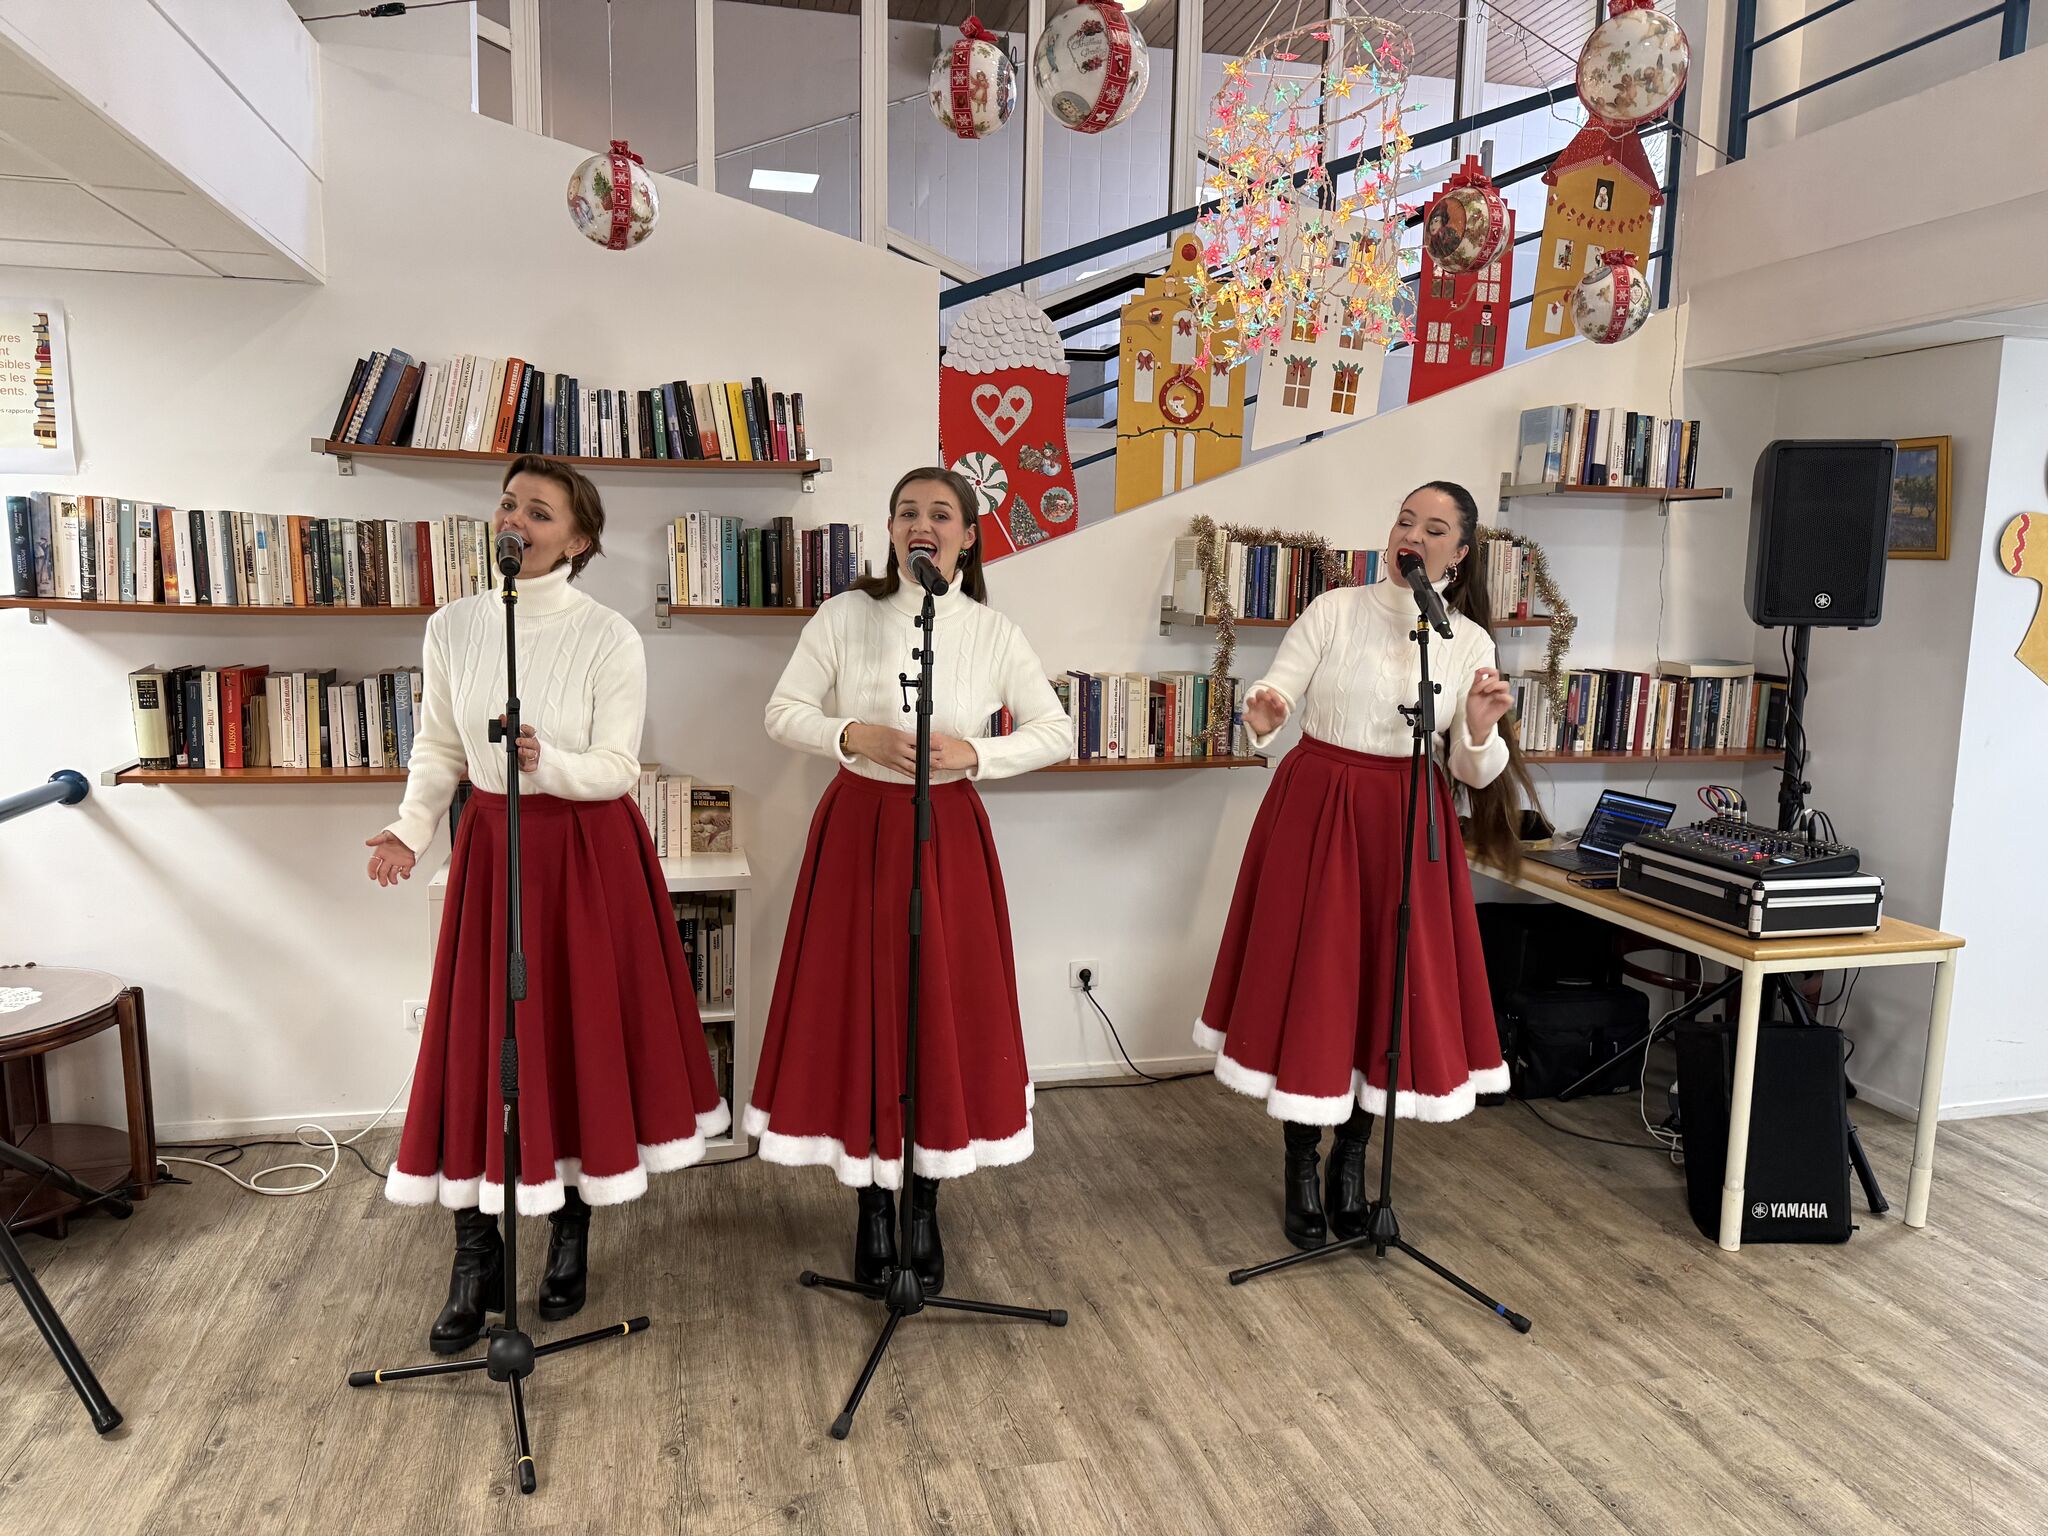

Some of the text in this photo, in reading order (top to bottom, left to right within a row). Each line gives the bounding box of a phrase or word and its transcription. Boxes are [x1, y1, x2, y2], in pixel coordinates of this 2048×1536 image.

[10, 373, 26, 382] les
[246, 545, 254, 577] AMNÉSIE
[396, 675, 408, 710] WERNER
[1711, 688, 1720, 714] ALIVE
[207, 709, 215, 726] BRIALY
[229, 722, 237, 753] MOUSSON
[1770, 1203, 1828, 1218] YAMAHA
